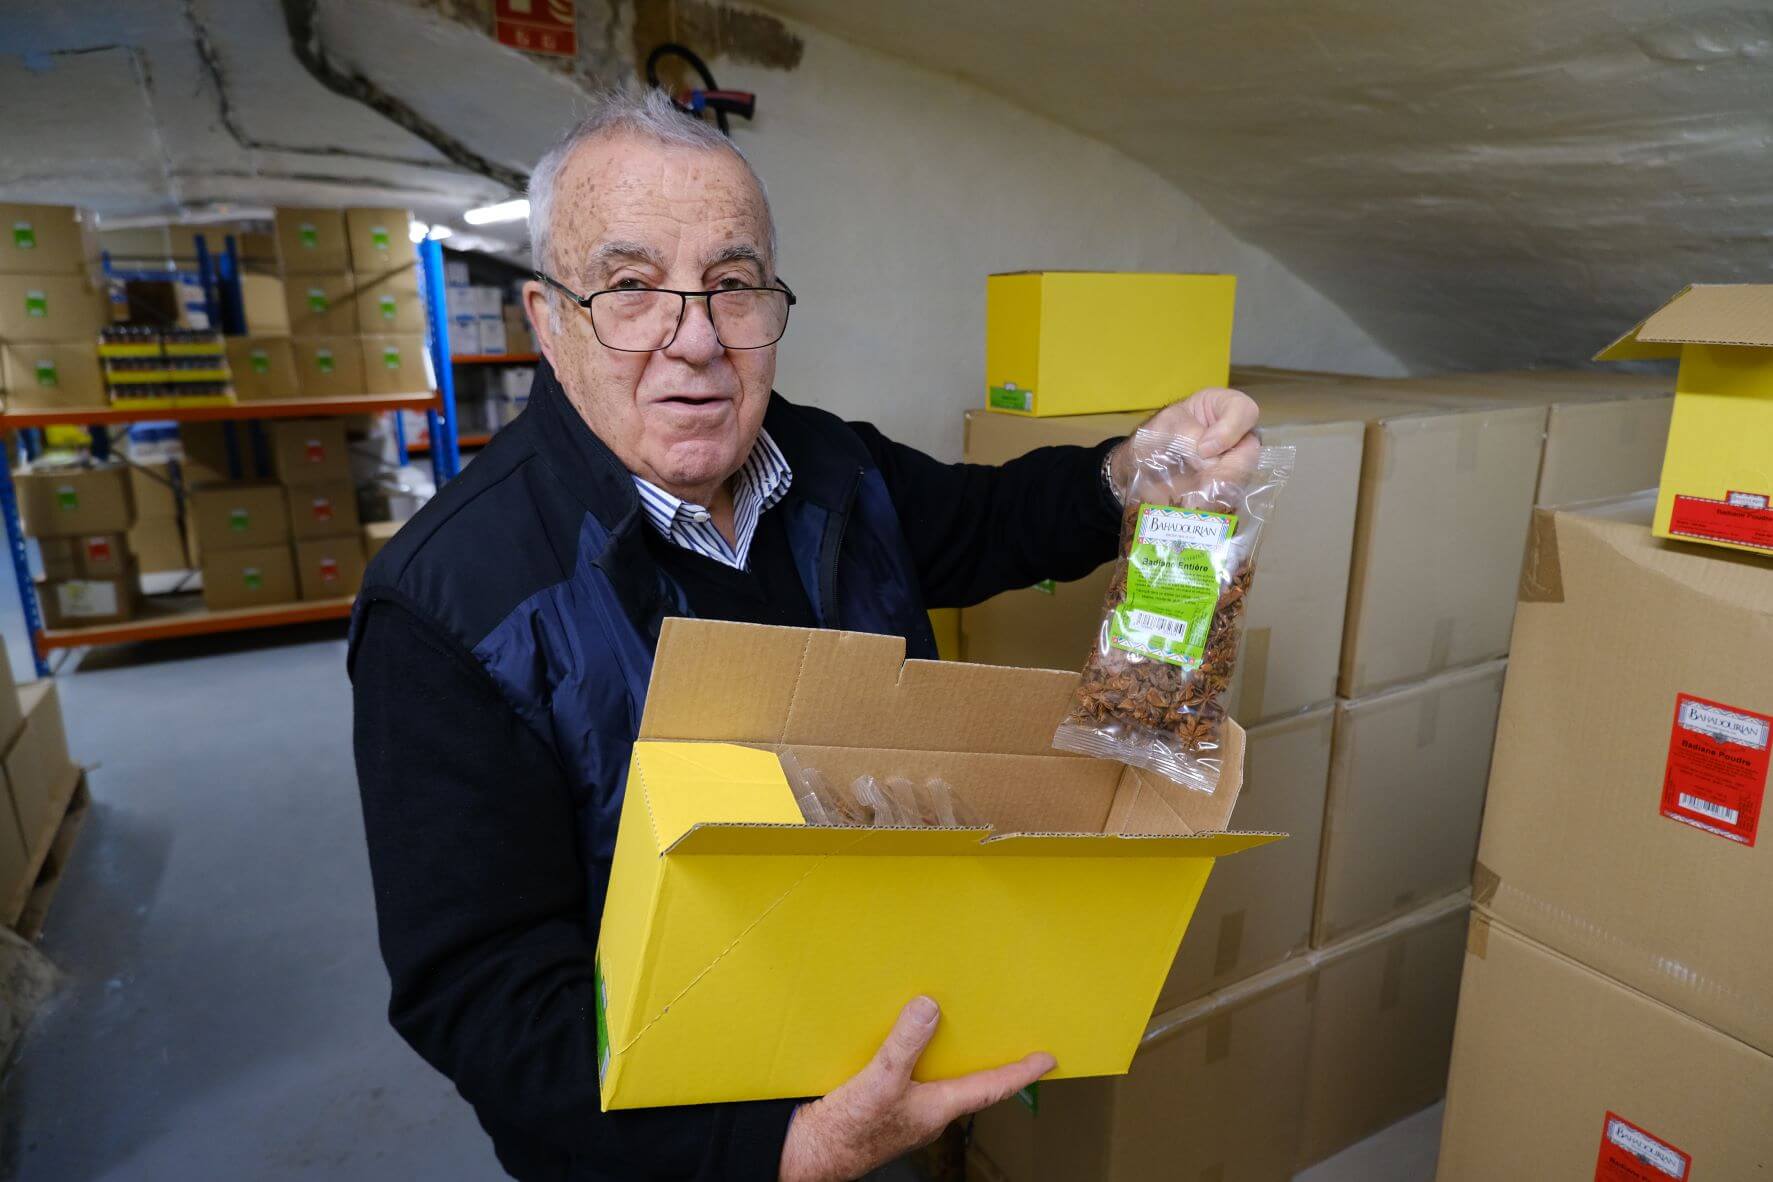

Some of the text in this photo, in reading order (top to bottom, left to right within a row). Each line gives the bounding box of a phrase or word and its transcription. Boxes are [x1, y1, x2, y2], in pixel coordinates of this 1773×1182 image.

[1149, 516, 1217, 537] BAHADOURIAN
[1689, 707, 1759, 737] BAHADOURIAN
[1682, 739, 1752, 767] Badiane Poudre
